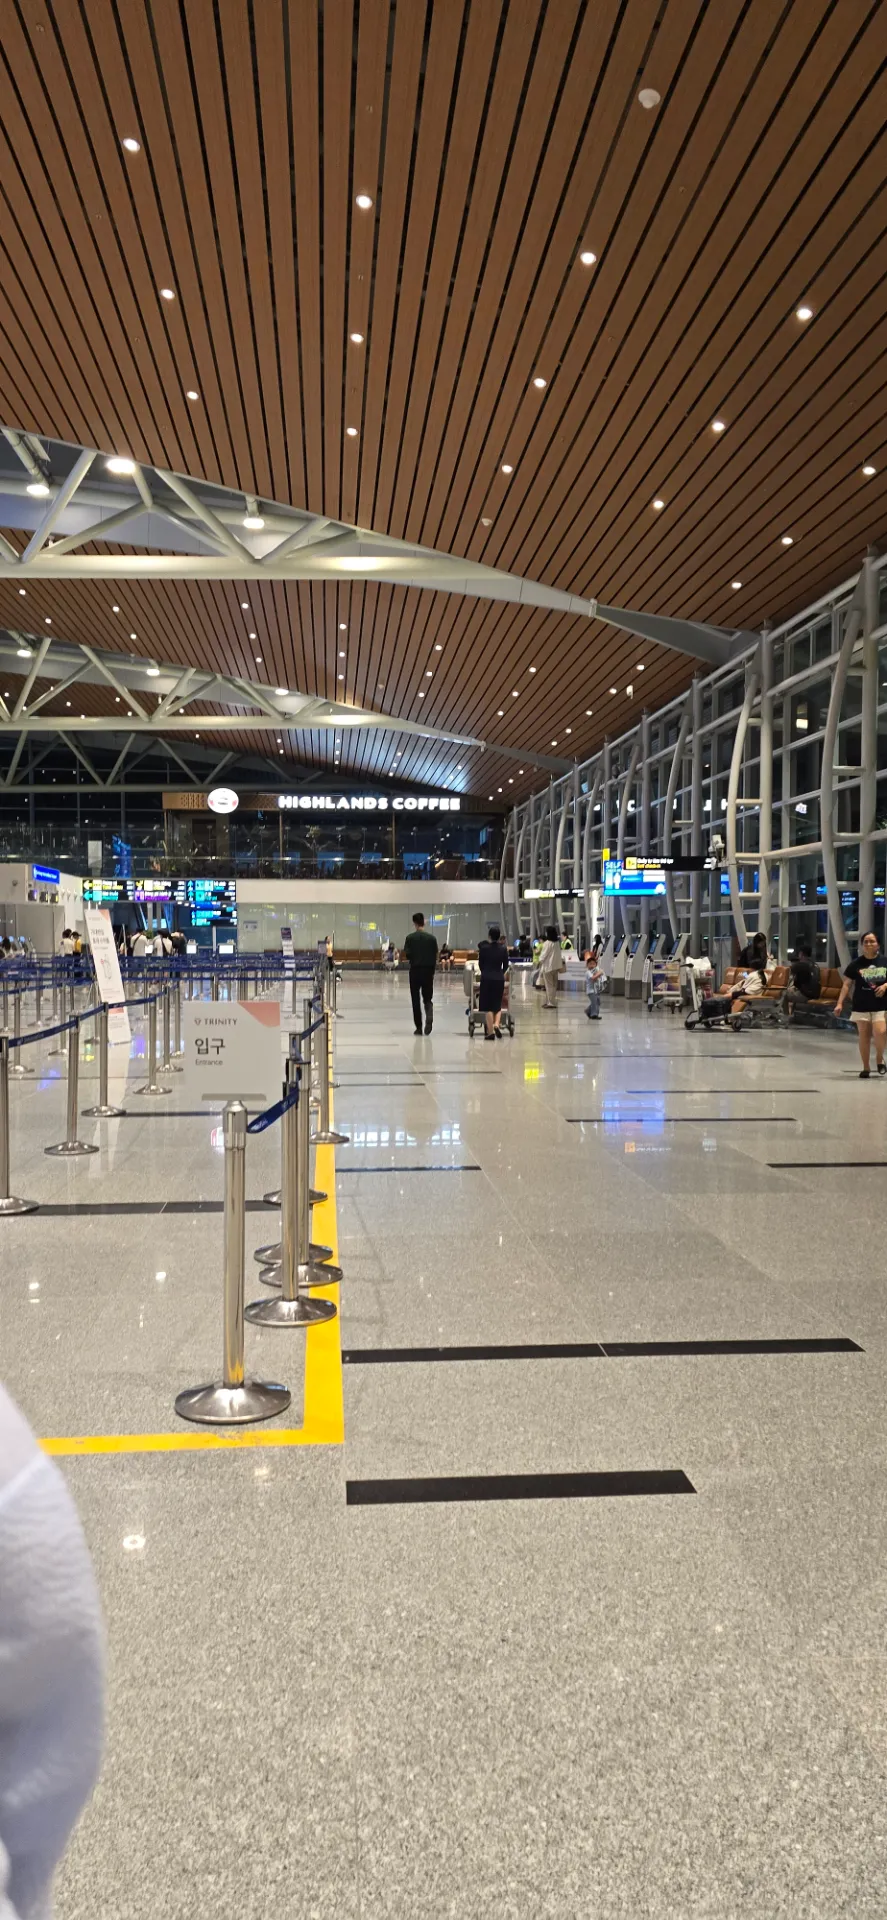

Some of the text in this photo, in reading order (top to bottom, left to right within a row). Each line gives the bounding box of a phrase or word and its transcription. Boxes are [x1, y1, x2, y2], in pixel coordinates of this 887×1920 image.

[278, 795, 461, 811] HIGHLANDS COFFEE
[605, 861, 621, 869] SELF
[204, 1018, 238, 1026] TRINITY
[194, 1037, 226, 1055] 입구
